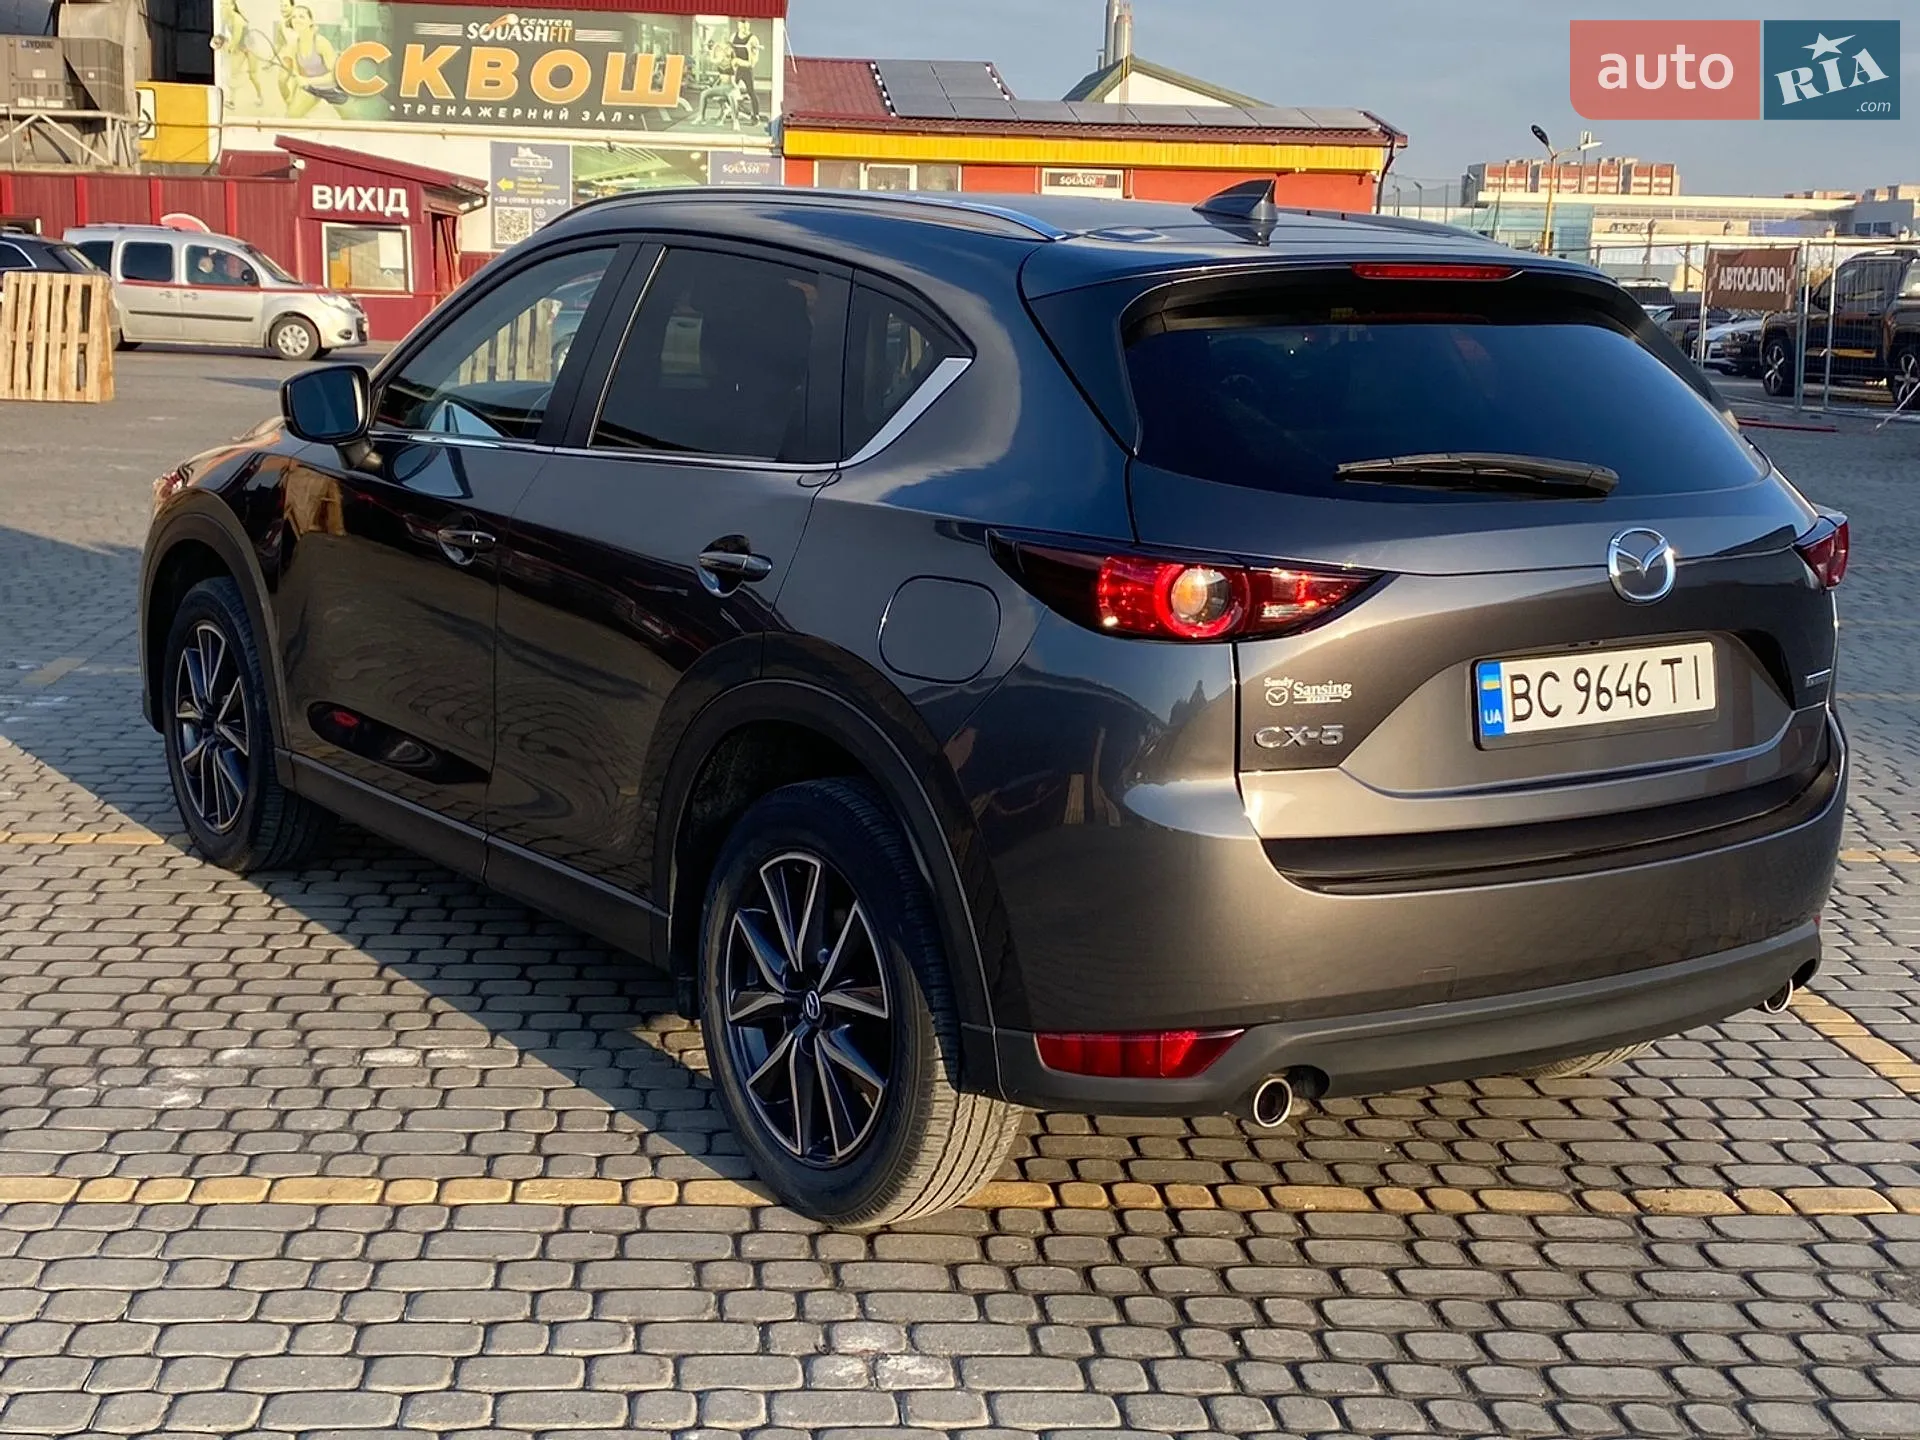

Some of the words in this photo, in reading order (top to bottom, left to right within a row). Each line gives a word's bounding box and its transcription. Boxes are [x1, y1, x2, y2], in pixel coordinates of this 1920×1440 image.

[520, 18, 573, 27] CENTER
[335, 40, 685, 108] СКВОШ
[402, 103, 569, 121] ТРЕНАЖЕРНИЙ
[581, 110, 623, 123] ЗАЛ
[312, 184, 410, 218] ВИХІД
[1718, 266, 1785, 293] АВТОСАЛОН
[1293, 680, 1353, 699] Sansing
[1509, 670, 1563, 722] BC
[1573, 660, 1652, 715] 9646
[1660, 654, 1701, 704] TI
[1484, 708, 1503, 725] UA
[1254, 724, 1345, 749] CX-5
